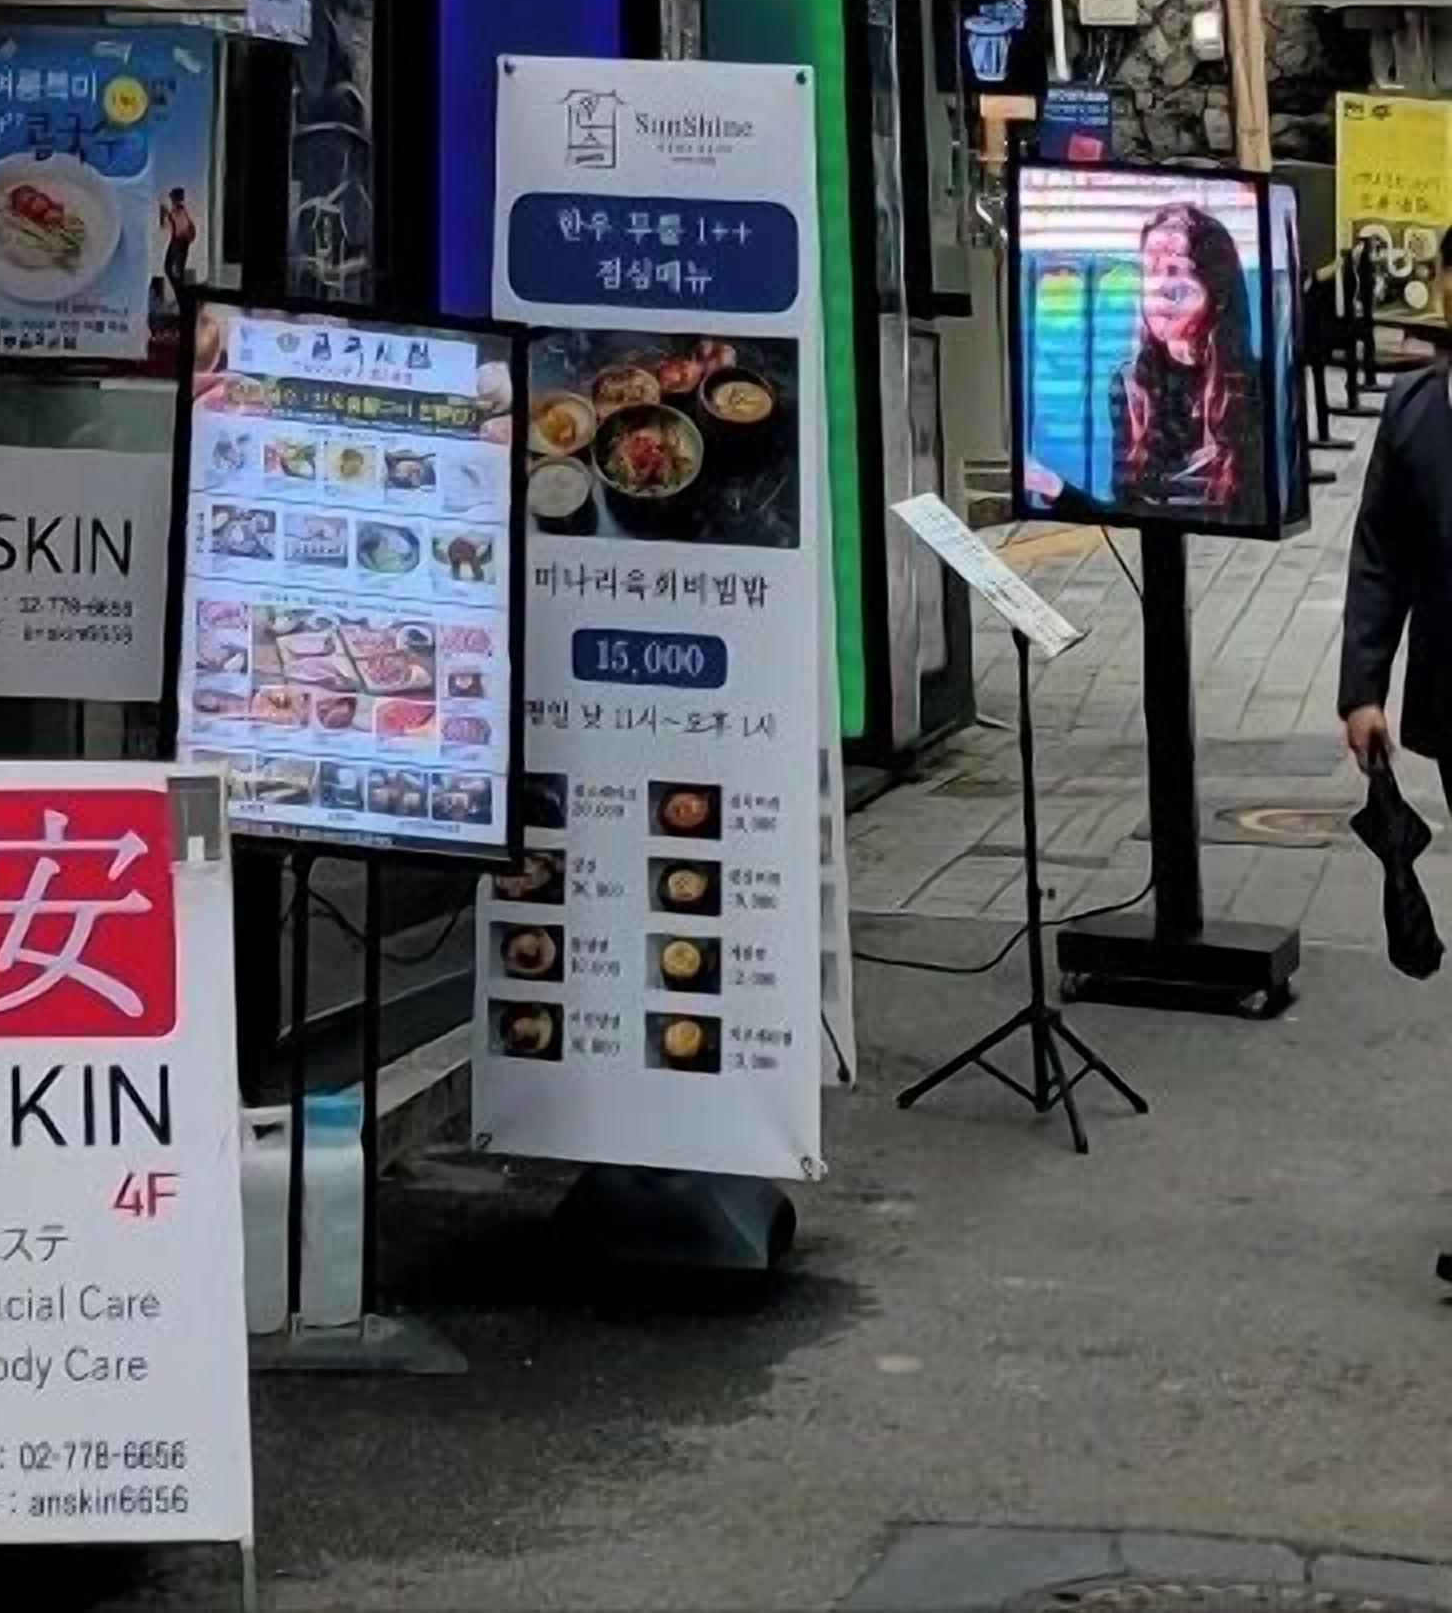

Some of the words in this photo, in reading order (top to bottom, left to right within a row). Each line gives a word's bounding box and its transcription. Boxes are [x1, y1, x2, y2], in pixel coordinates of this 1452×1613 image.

[597, 256, 713, 294] 점심메뉴
[112, 1170, 181, 1217] 4F
[79, 1284, 161, 1322] Care
[64, 1345, 150, 1382] Care
